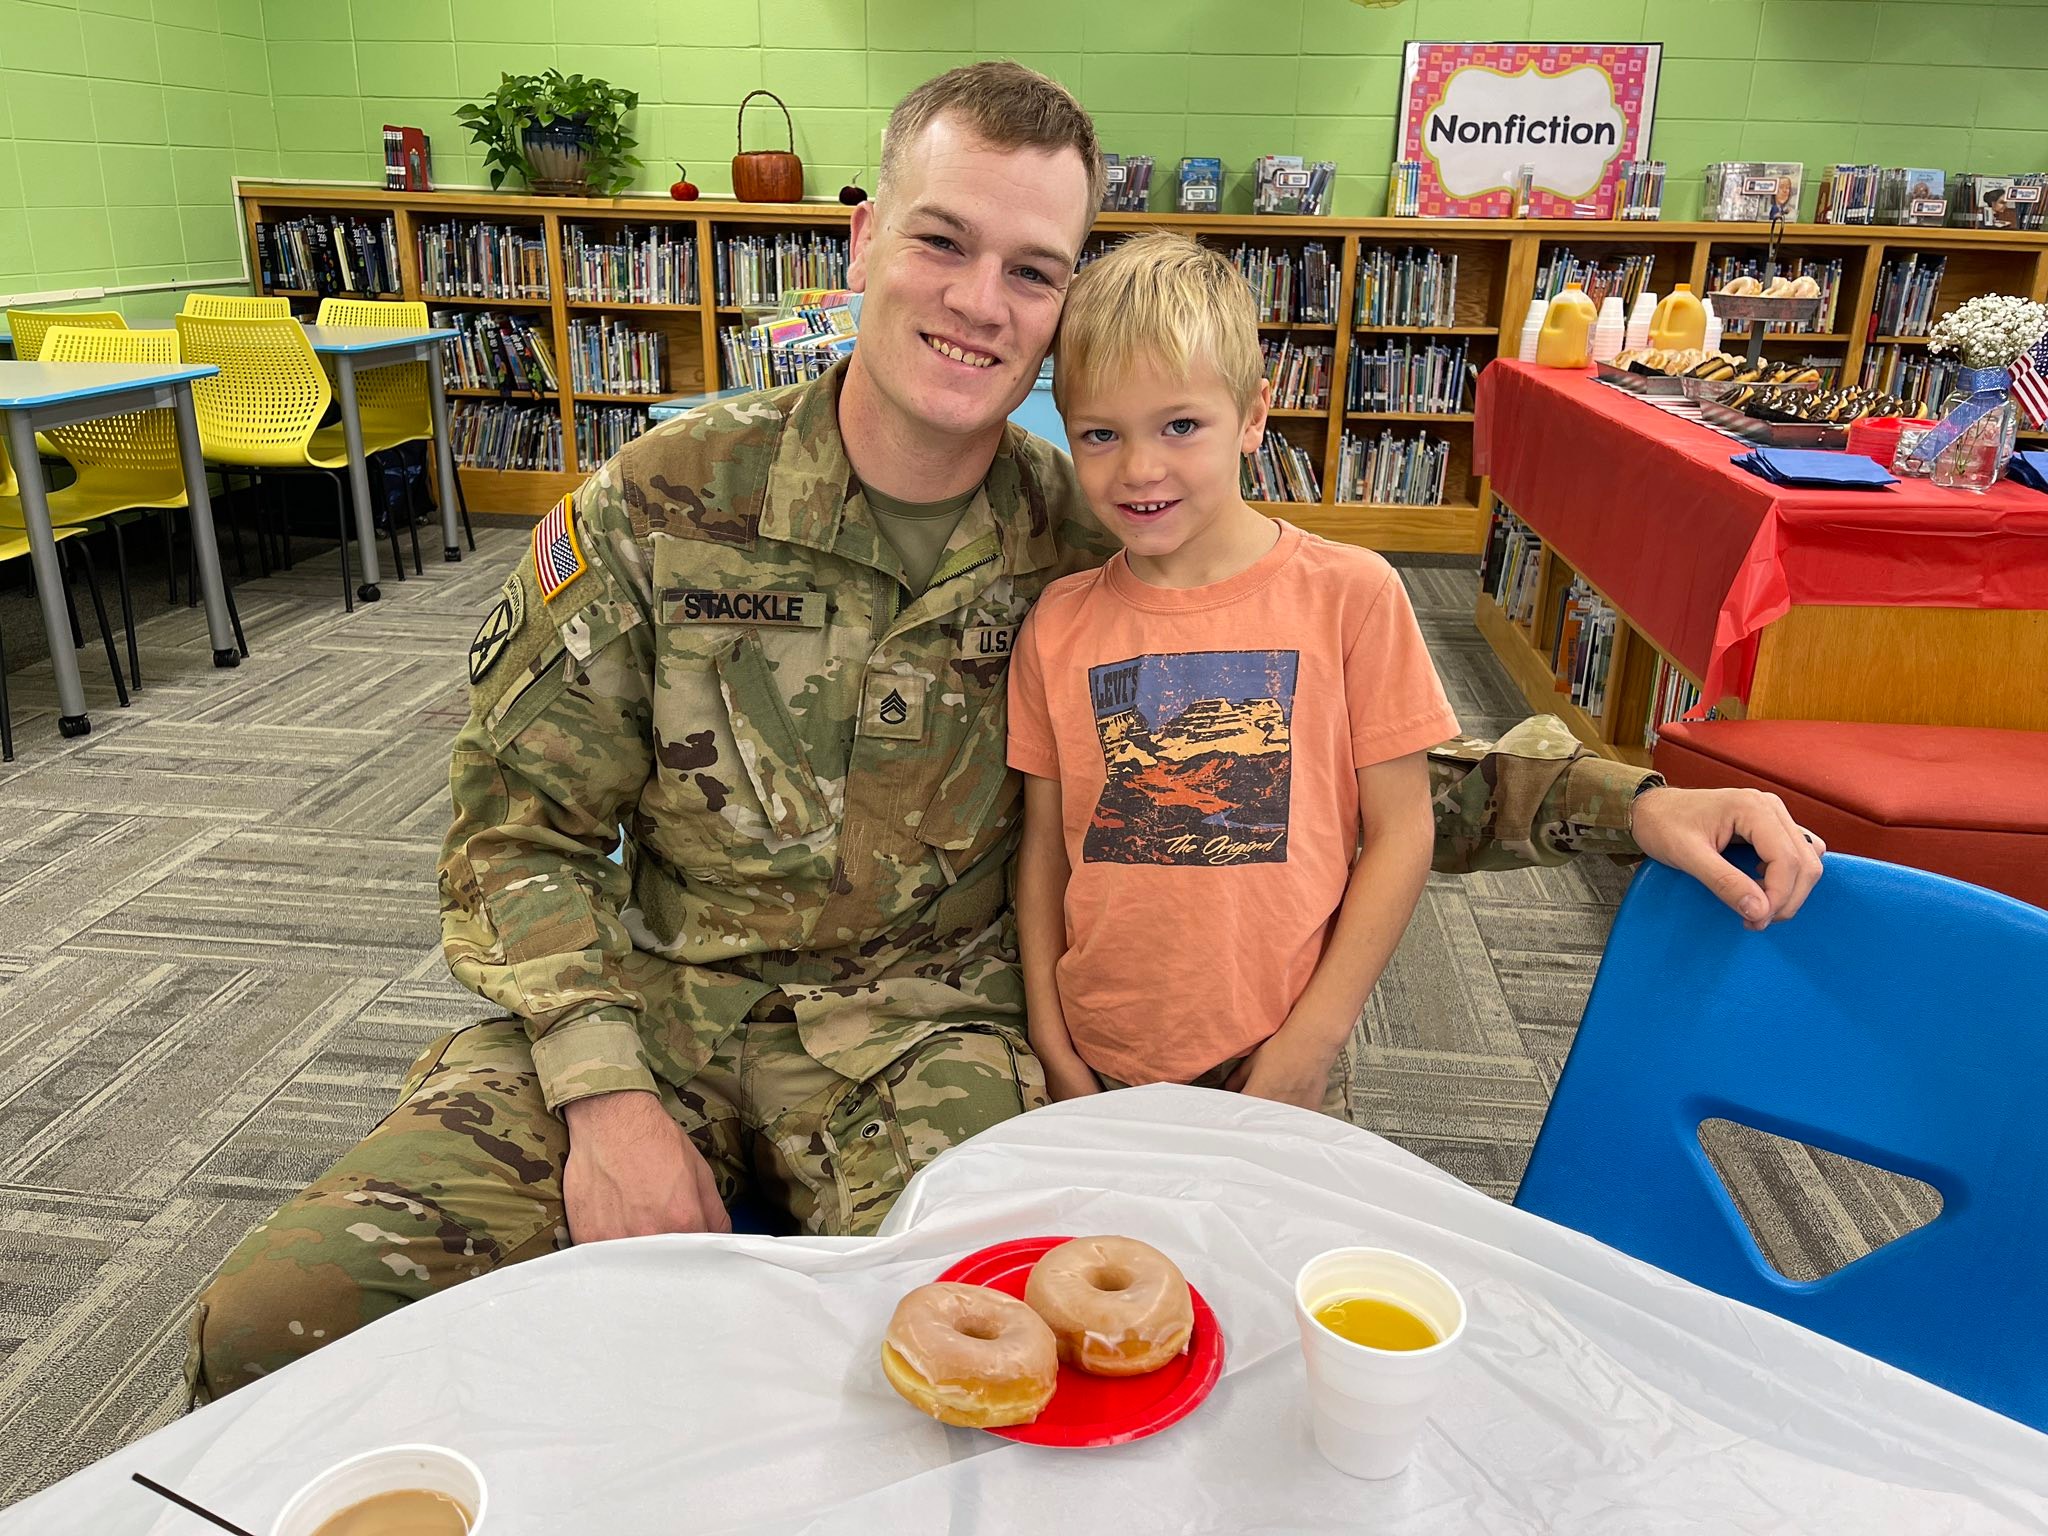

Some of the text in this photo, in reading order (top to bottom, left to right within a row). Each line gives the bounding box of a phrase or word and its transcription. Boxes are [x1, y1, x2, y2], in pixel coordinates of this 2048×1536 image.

[1430, 114, 1616, 145] Nonfiction
[684, 593, 804, 622] STACKLE
[1095, 665, 1138, 709] LEVI'S
[1165, 833, 1284, 864] The Original
